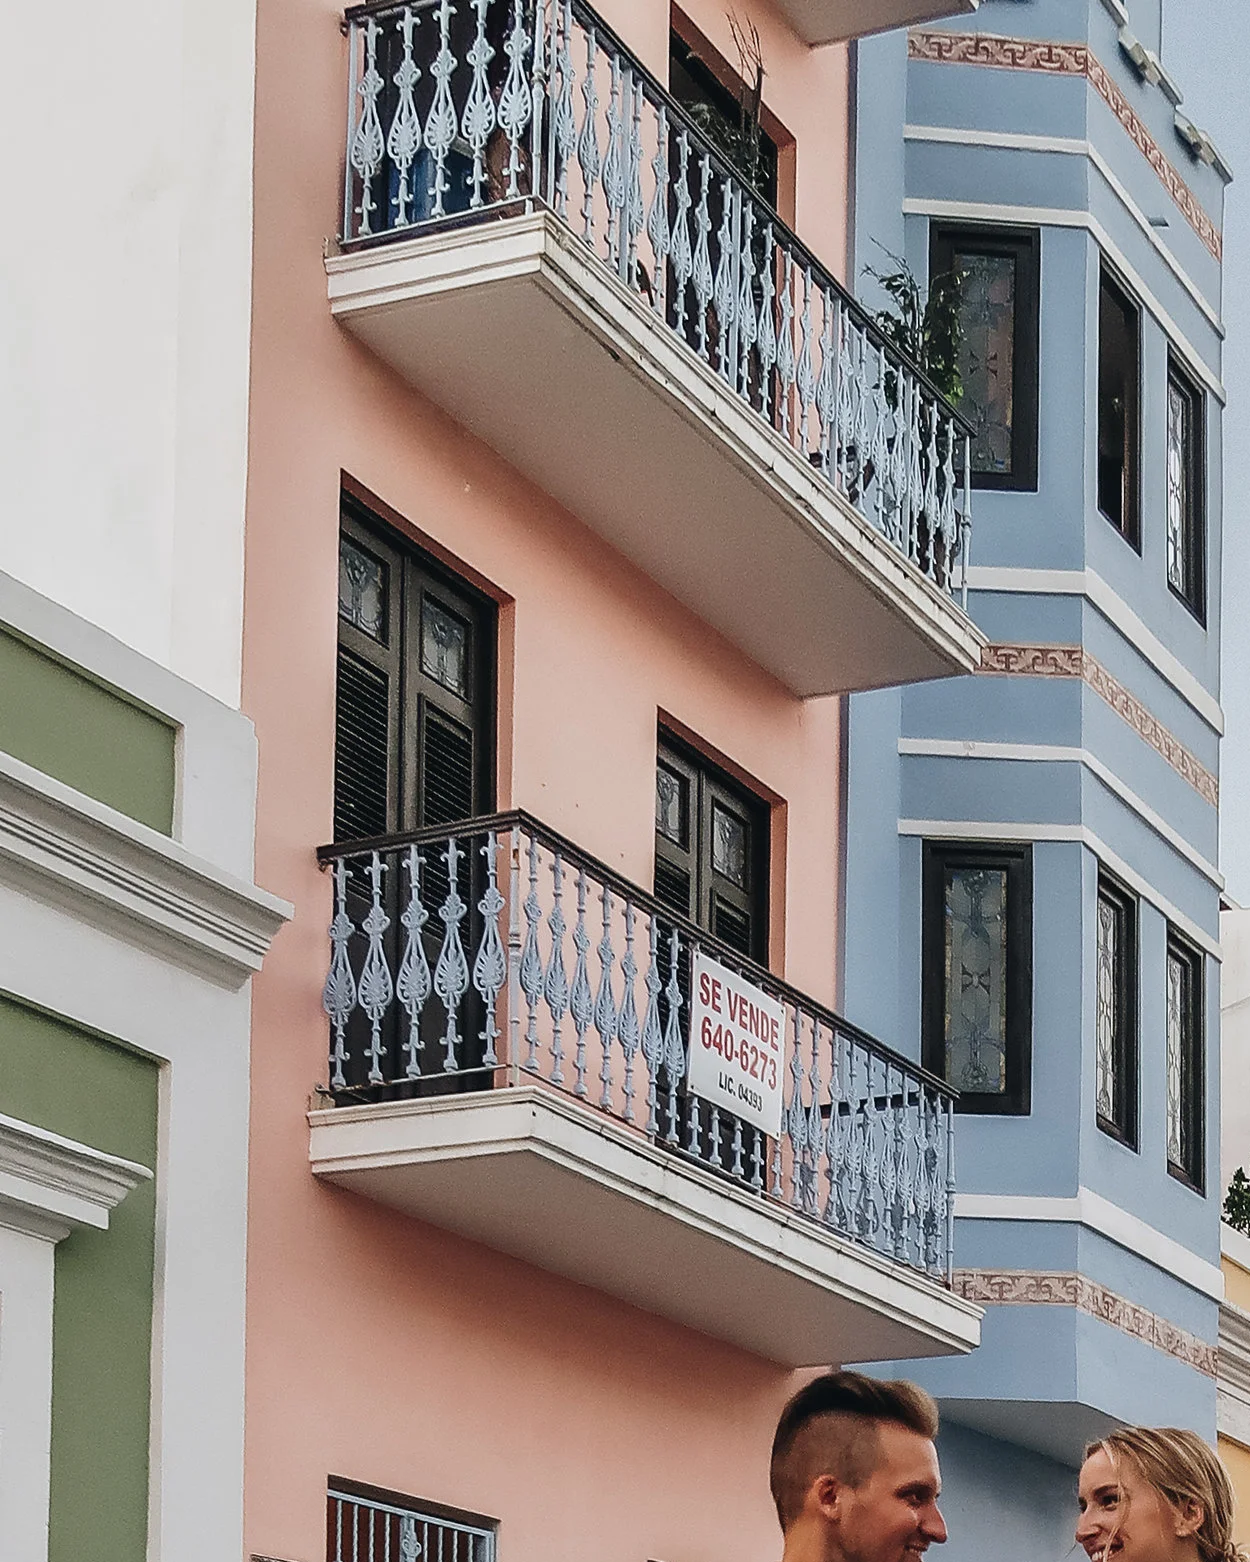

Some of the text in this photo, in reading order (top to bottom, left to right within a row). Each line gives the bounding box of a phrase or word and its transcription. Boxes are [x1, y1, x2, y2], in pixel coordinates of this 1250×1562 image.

[699, 972, 779, 1052] SE VENDE
[701, 1016, 777, 1090] 640-6273
[719, 1071, 736, 1096] LIC.
